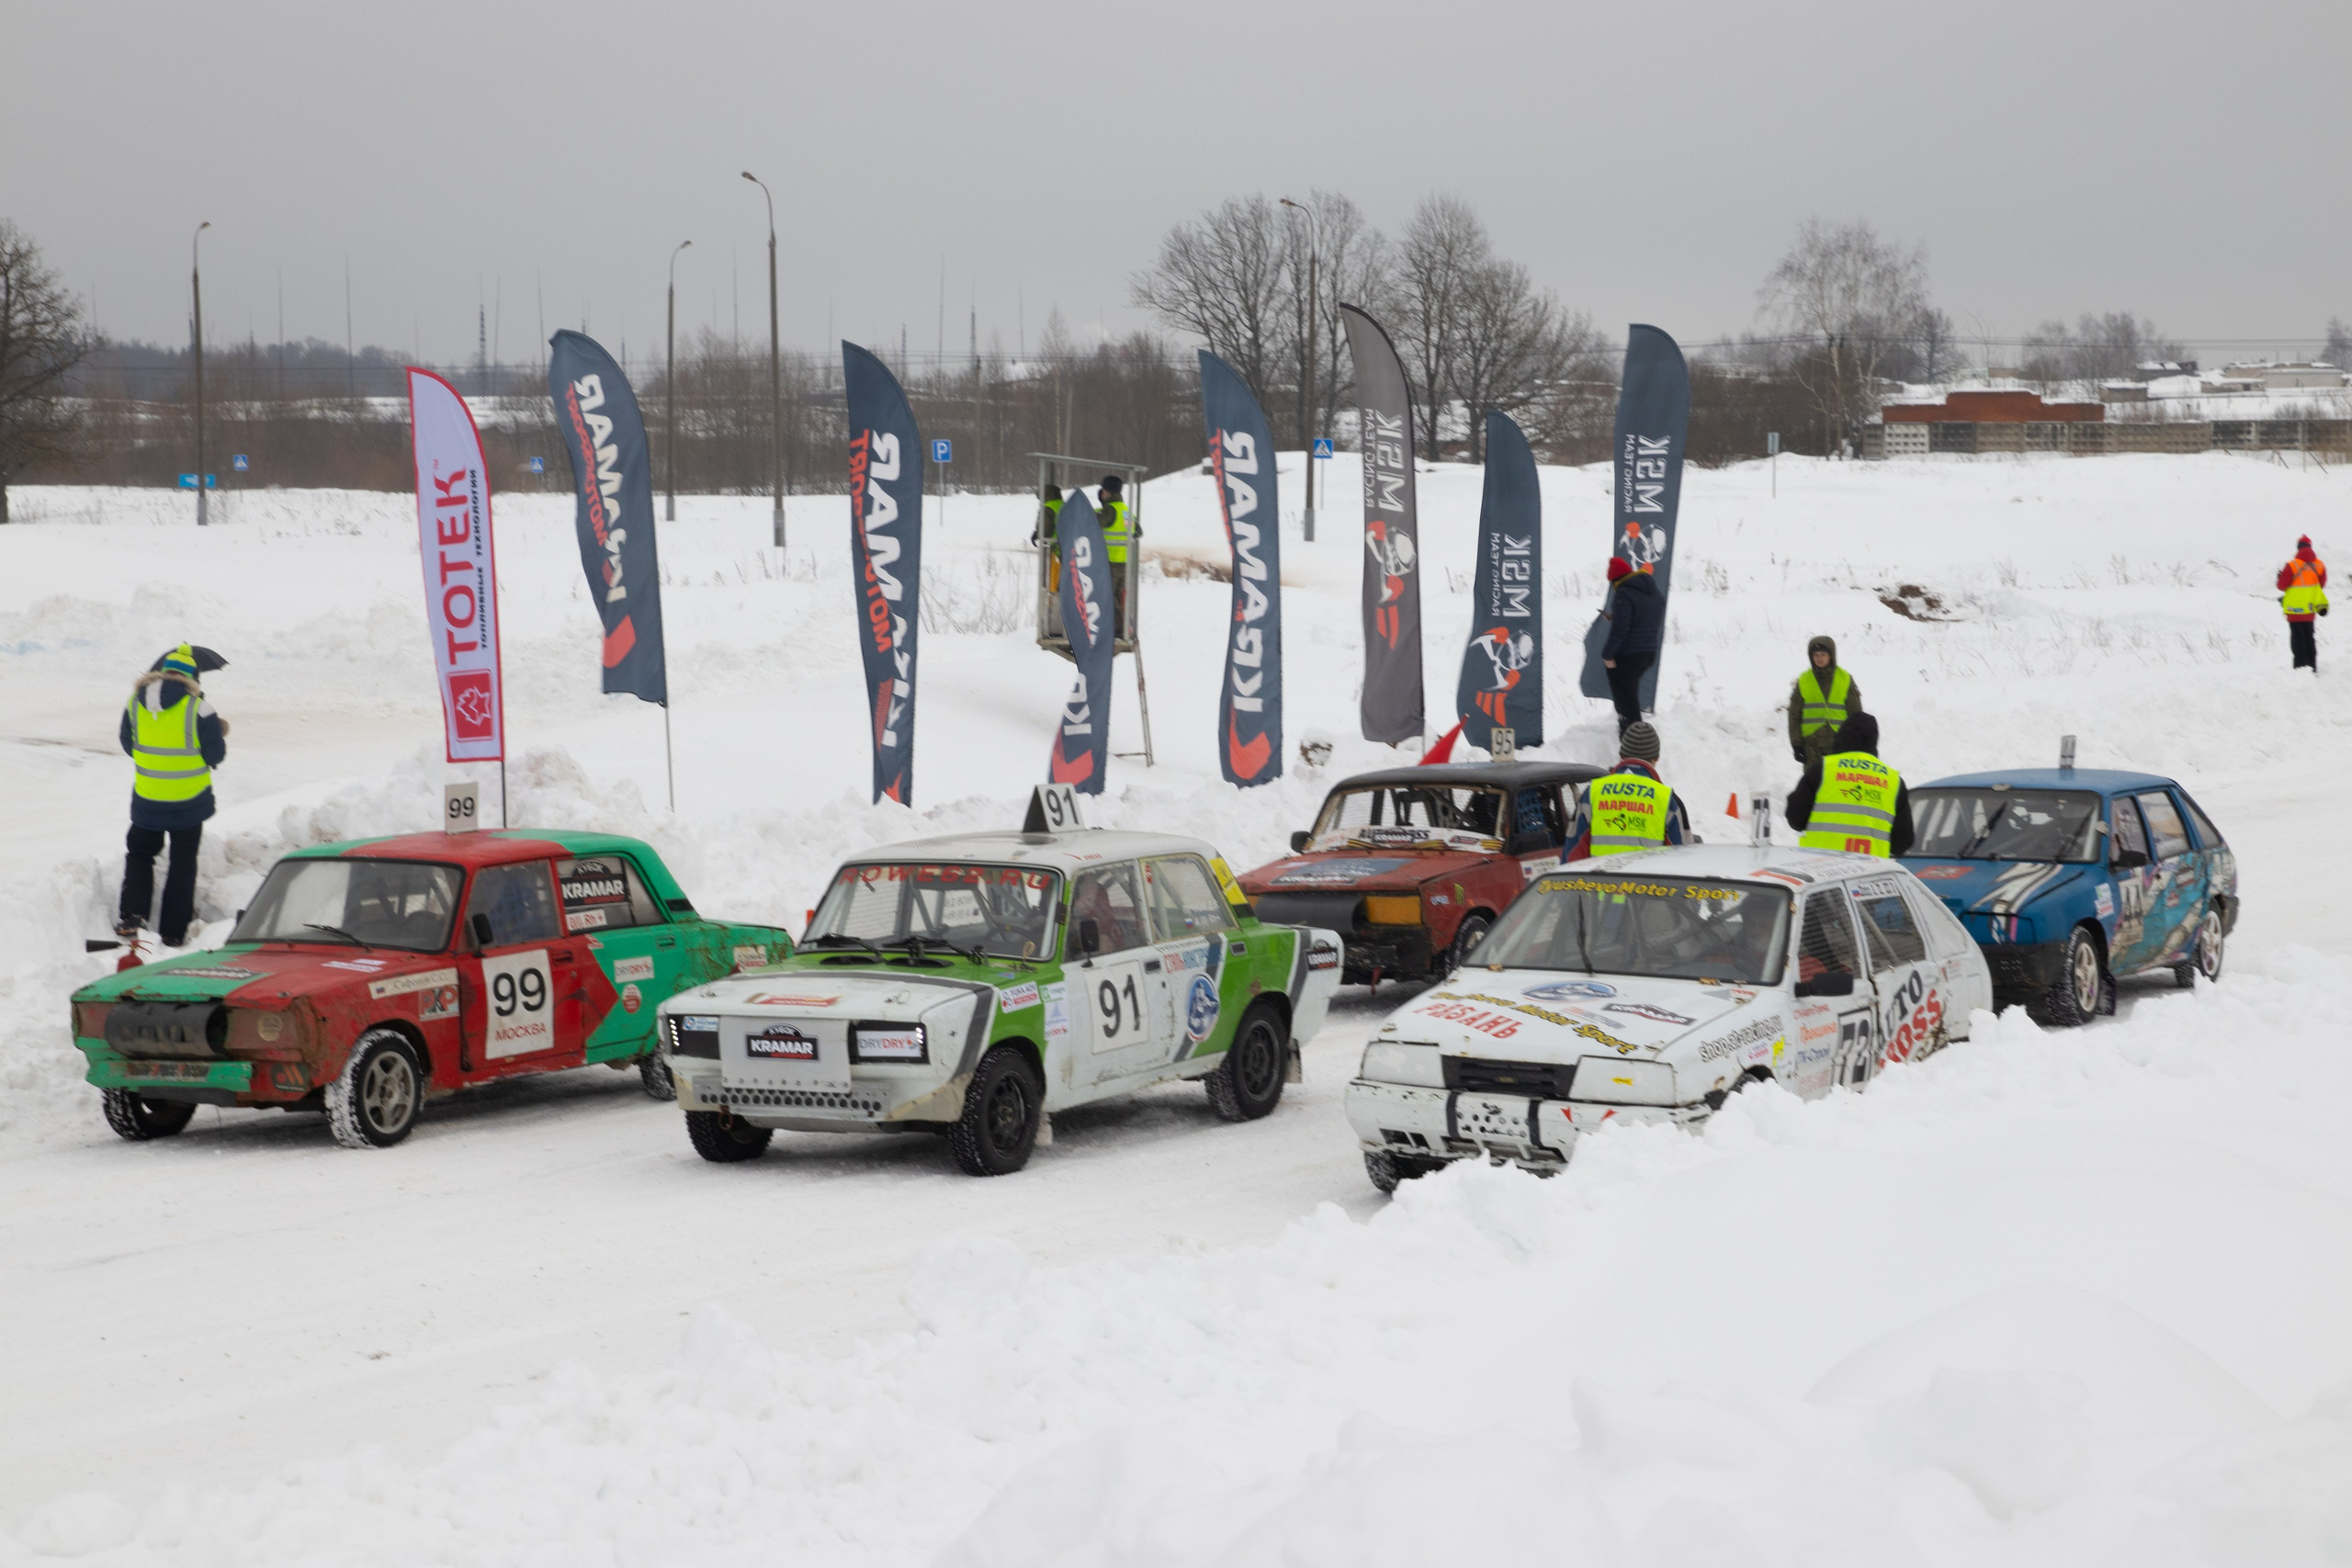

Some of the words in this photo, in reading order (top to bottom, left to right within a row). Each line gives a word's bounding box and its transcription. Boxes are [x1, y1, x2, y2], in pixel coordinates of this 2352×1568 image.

[937, 442, 948, 460] P
[469, 468, 483, 558] ТЕХНОЛОГИИ
[477, 566, 489, 650] ТОПЛИВНЫЕ
[1495, 730, 1512, 755] 95
[1838, 758, 1888, 776] RUSTA
[1601, 783, 1655, 799] RUSTA
[1836, 772, 1888, 789] МАРШАЛ
[448, 796, 475, 818] 99
[1046, 787, 1080, 827] 91
[1599, 800, 1654, 815] МАРШАЛ
[839, 864, 1051, 891] ROWE62.RU
[562, 879, 625, 899] KRAMAR
[493, 968, 546, 1017] 99
[1100, 974, 1140, 1038] 91
[495, 1021, 547, 1043] МОСКВА
[750, 1039, 814, 1055] KRAMAR
